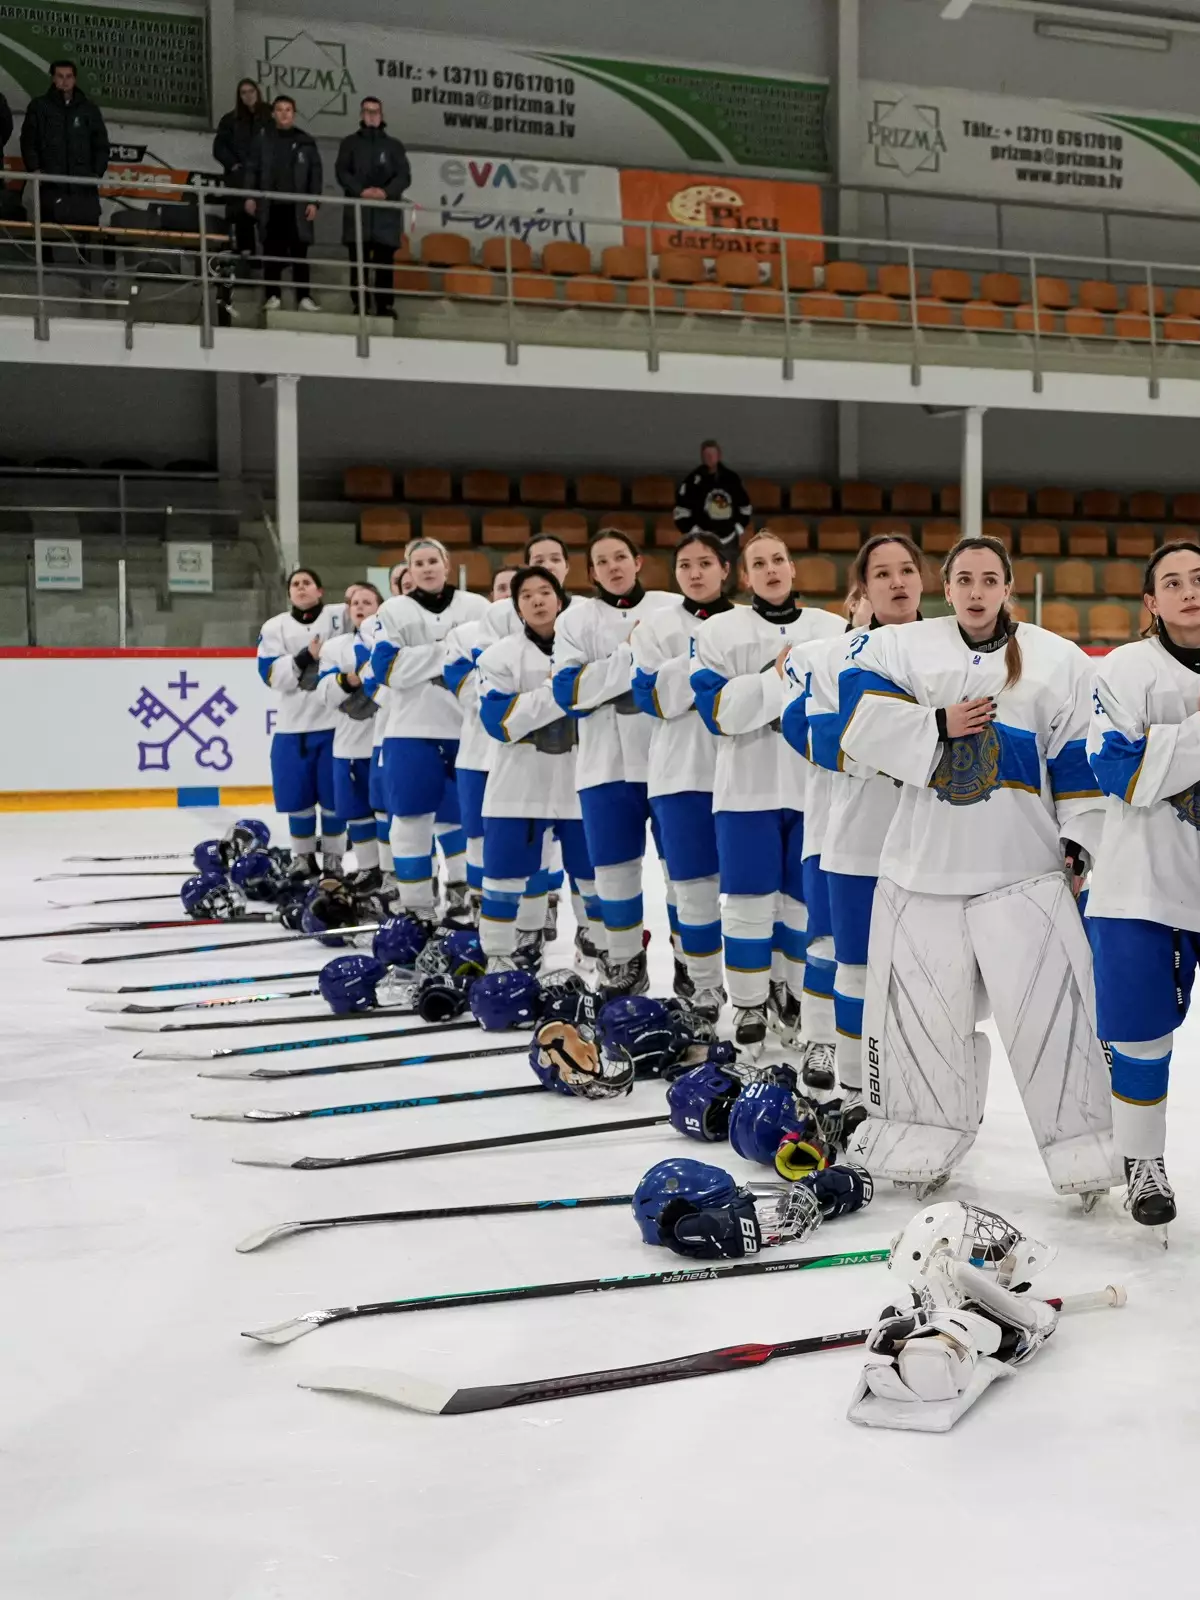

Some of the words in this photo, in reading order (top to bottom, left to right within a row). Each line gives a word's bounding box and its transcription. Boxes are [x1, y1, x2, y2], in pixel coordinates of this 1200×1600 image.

[256, 60, 357, 94] PRIZMA
[443, 66, 487, 87] (371)
[493, 70, 575, 96] 67617010
[411, 86, 575, 117] prizma@prizma.lv
[443, 111, 575, 138] www.prizma.lv
[867, 120, 947, 153] PRIZMA
[1016, 126, 1053, 145] (371)
[869, 1036, 881, 1107] BAUER
[685, 1116, 700, 1132] 15
[662, 1272, 711, 1284] BAUER
